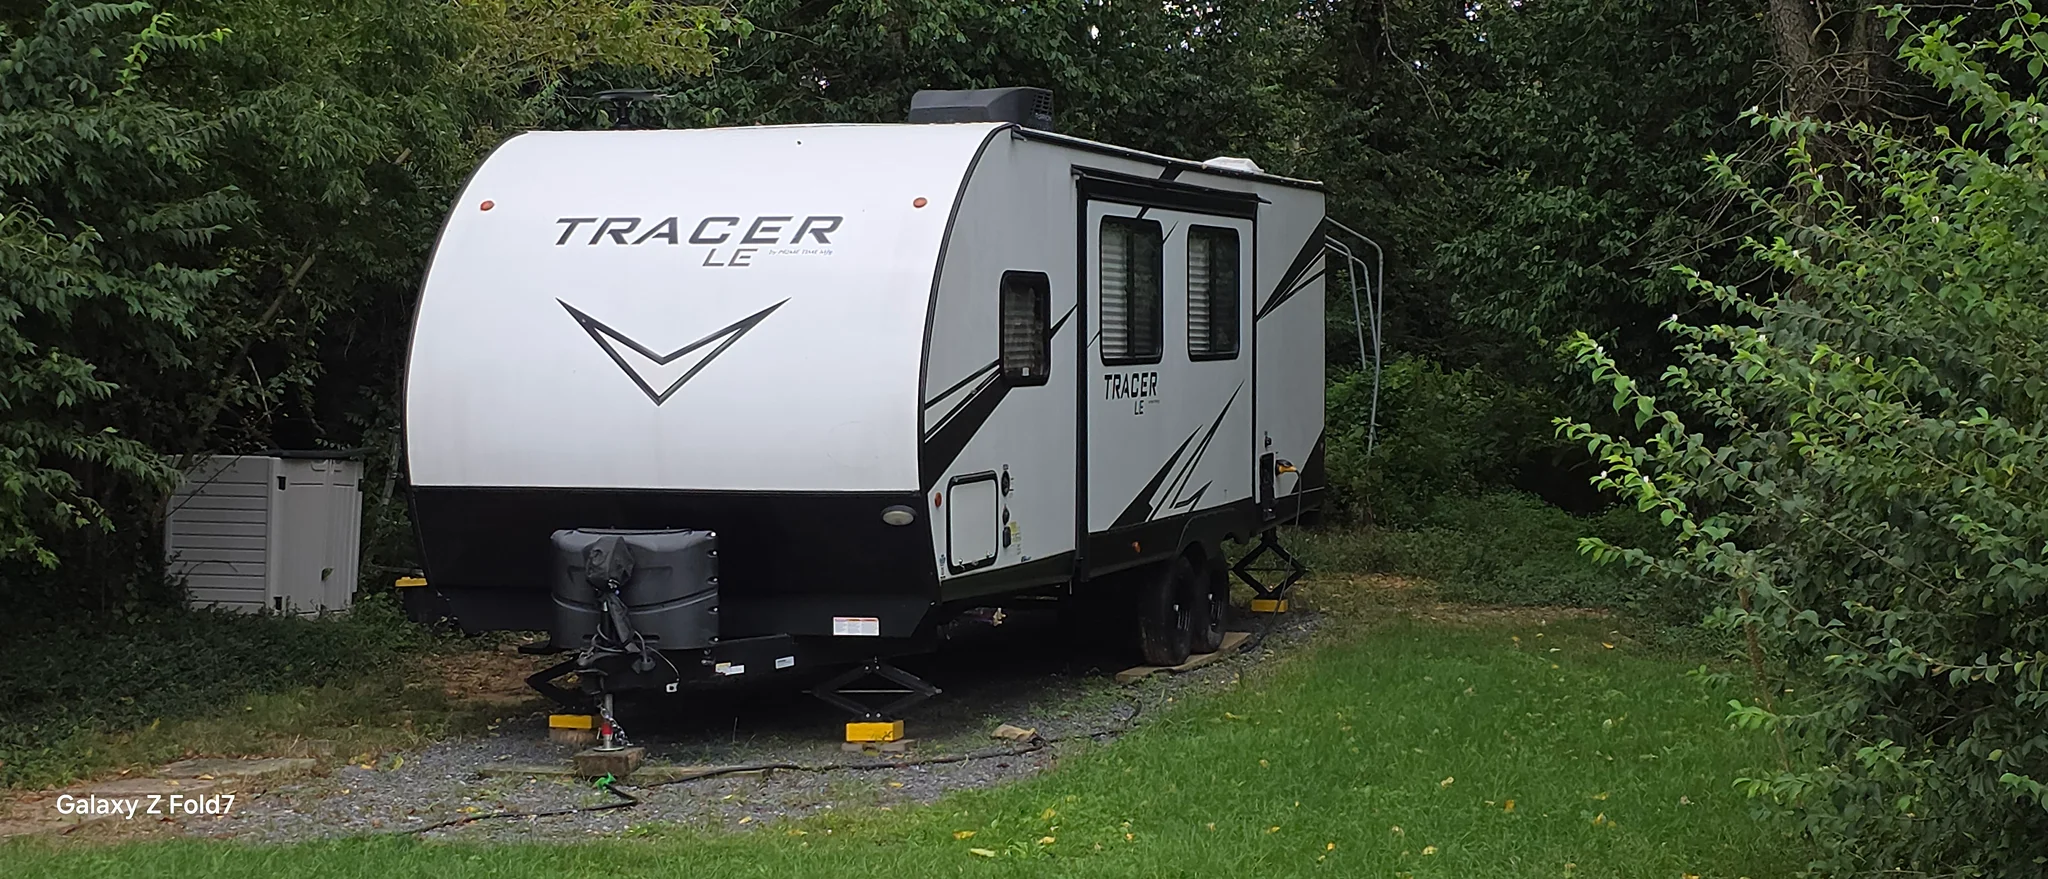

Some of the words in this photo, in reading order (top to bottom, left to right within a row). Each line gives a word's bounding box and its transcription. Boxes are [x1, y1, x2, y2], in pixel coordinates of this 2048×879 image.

[555, 215, 844, 246] TRACER
[702, 248, 759, 267] LE
[1104, 372, 1159, 400] TRACER
[1134, 400, 1145, 416] LE
